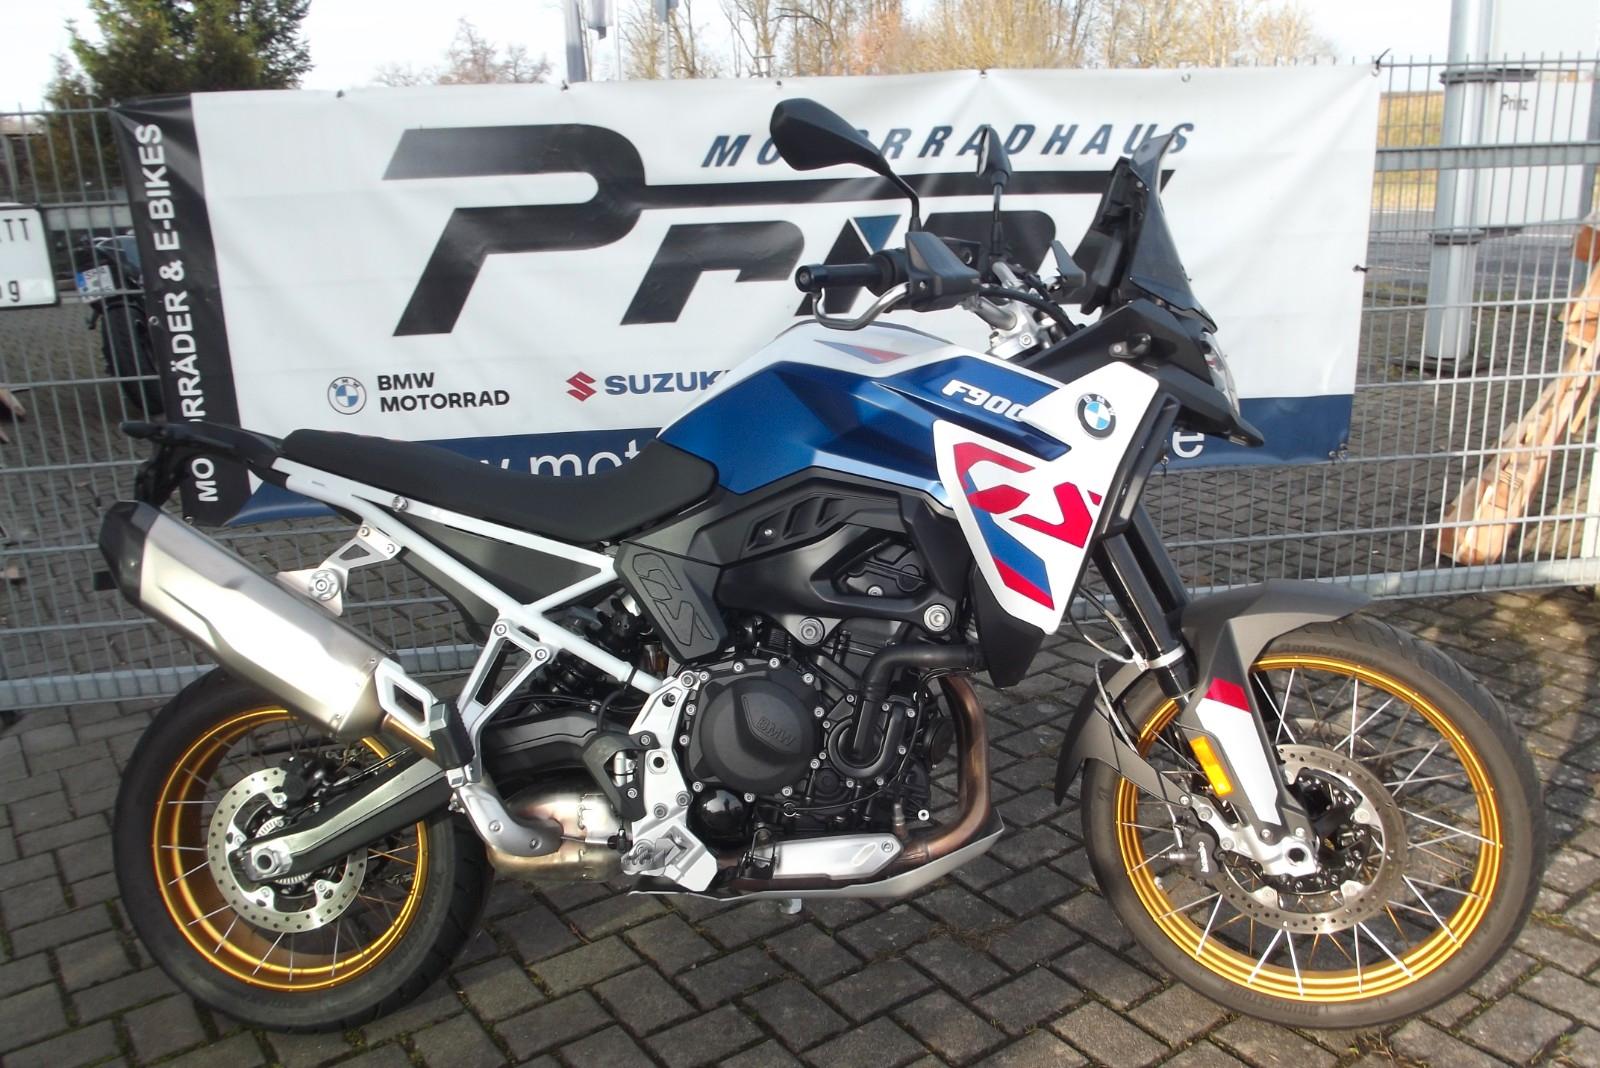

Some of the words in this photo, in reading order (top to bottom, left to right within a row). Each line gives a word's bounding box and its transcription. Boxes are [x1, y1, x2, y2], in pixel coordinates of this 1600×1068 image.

[701, 122, 1196, 168] MORRADHAUS
[135, 124, 180, 251] E-BIKES
[159, 259, 184, 282] &
[377, 372, 435, 391] BMW
[604, 370, 731, 395] SUZUK
[164, 291, 219, 502] MORRÄDER
[380, 390, 510, 412] MOTORRAD
[755, 716, 797, 746] BMW
